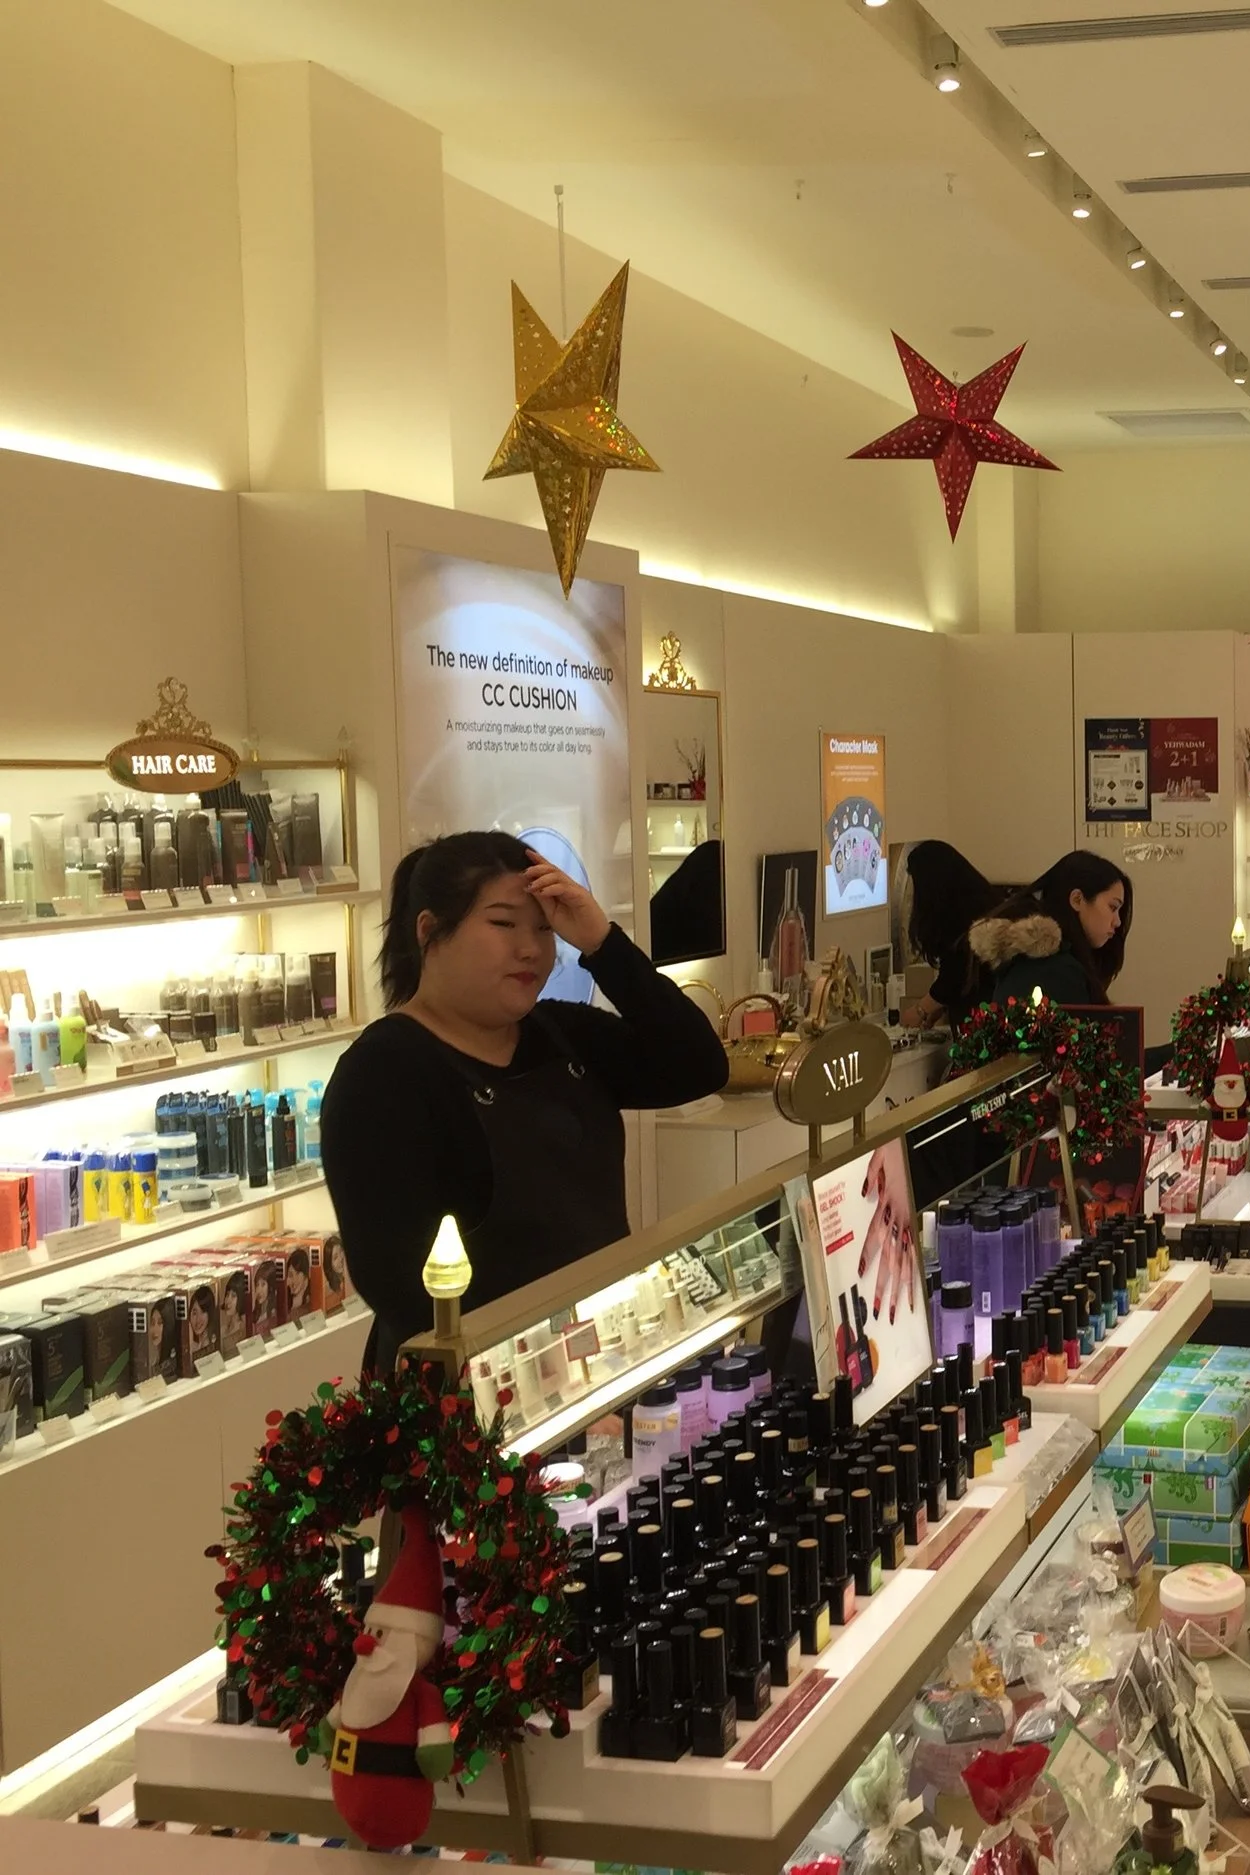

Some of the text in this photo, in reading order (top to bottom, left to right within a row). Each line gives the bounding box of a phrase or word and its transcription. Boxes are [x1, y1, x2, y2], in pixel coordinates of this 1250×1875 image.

[426, 644, 614, 685] The new definition of makeup
[482, 683, 577, 711] CC CUSHION
[446, 719, 454, 731] A
[455, 721, 503, 736] moisturizing
[504, 723, 533, 736] makeup
[533, 723, 547, 734] that
[548, 726, 565, 737] goes
[565, 726, 574, 734] on
[467, 739, 482, 751] and
[483, 740, 503, 753] stays
[504, 741, 520, 752] true
[520, 742, 528, 751] to
[529, 742, 538, 752] its
[539, 742, 556, 752] color
[565, 743, 577, 754] day
[829, 738, 878, 754] Character Mask
[1164, 740, 1206, 749] YEHWADAM
[131, 754, 216, 775] HAIR CARE
[1169, 750, 1199, 767] 2+1
[1125, 821, 1171, 838] FACE
[1175, 821, 1227, 839] SHOP
[823, 1051, 863, 1096] NAIL
